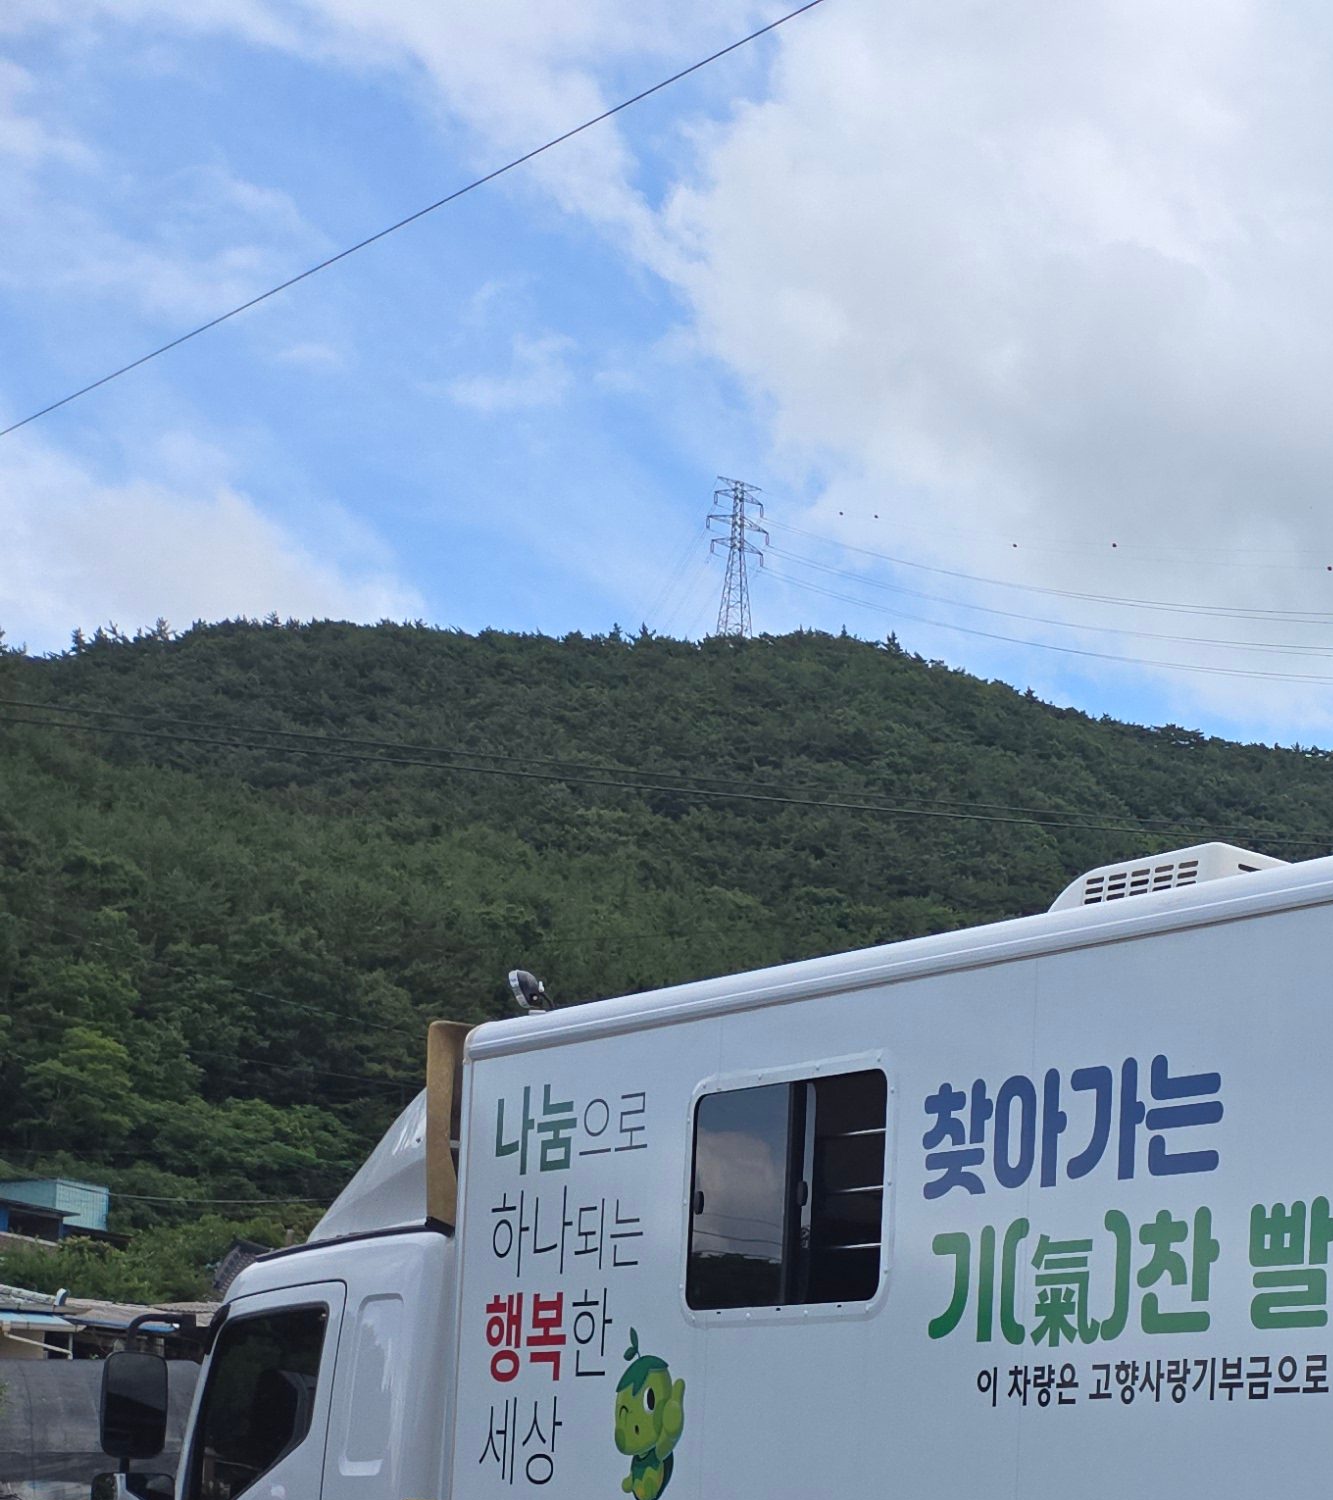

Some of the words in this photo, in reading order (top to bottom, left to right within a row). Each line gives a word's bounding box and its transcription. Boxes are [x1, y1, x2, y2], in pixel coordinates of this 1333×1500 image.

[494, 1083, 648, 1175] 나눔으로
[922, 1054, 1224, 1199] 찾아가는
[490, 1185, 644, 1278] 하나되는
[927, 1205, 1220, 1347] 기(氣)찬
[486, 1287, 613, 1383] 행복한
[977, 1367, 999, 1408] 이
[1008, 1361, 1080, 1406] 차량은
[1088, 1353, 1330, 1403] 고향사랑기부금으로
[478, 1396, 563, 1486] 세상
